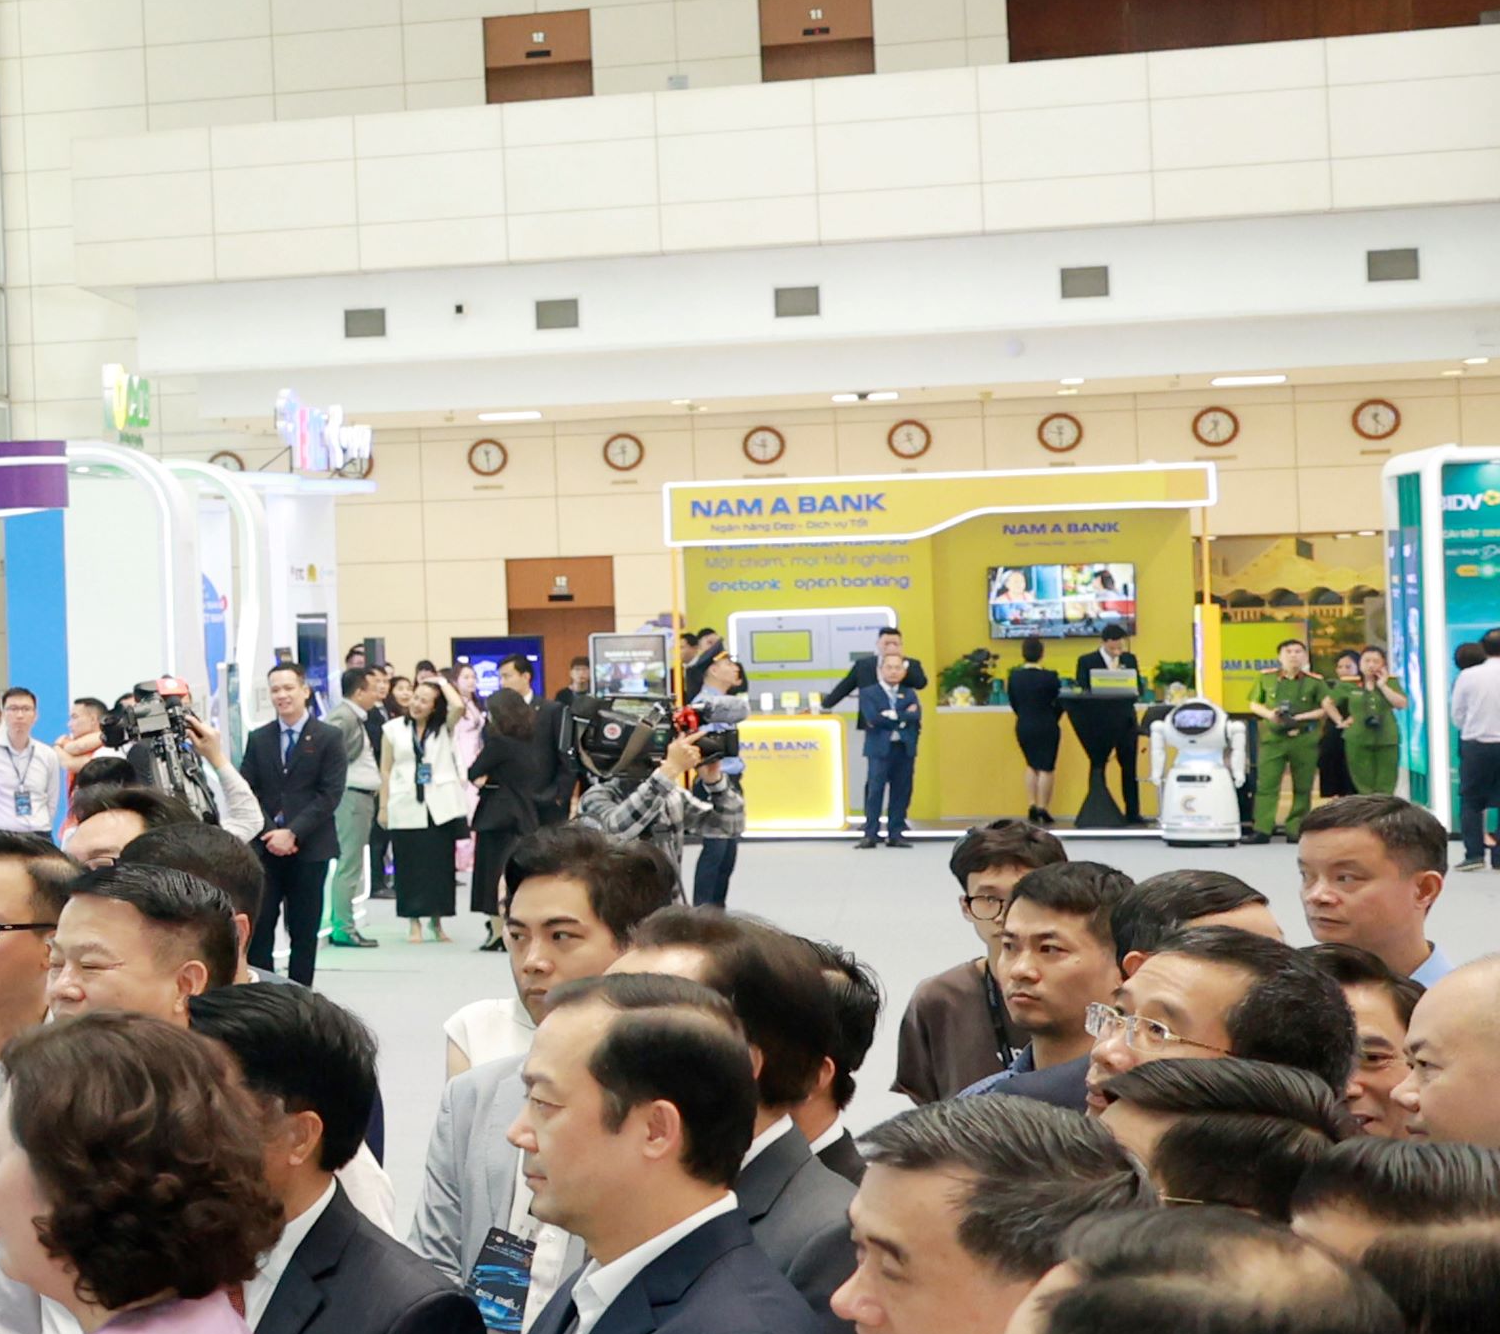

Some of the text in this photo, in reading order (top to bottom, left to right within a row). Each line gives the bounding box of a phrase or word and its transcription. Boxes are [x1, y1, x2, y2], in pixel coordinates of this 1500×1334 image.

[691, 493, 887, 518] NAM A BANK
[1003, 522, 1121, 535] NAM A BANK
[773, 741, 820, 752] BANK
